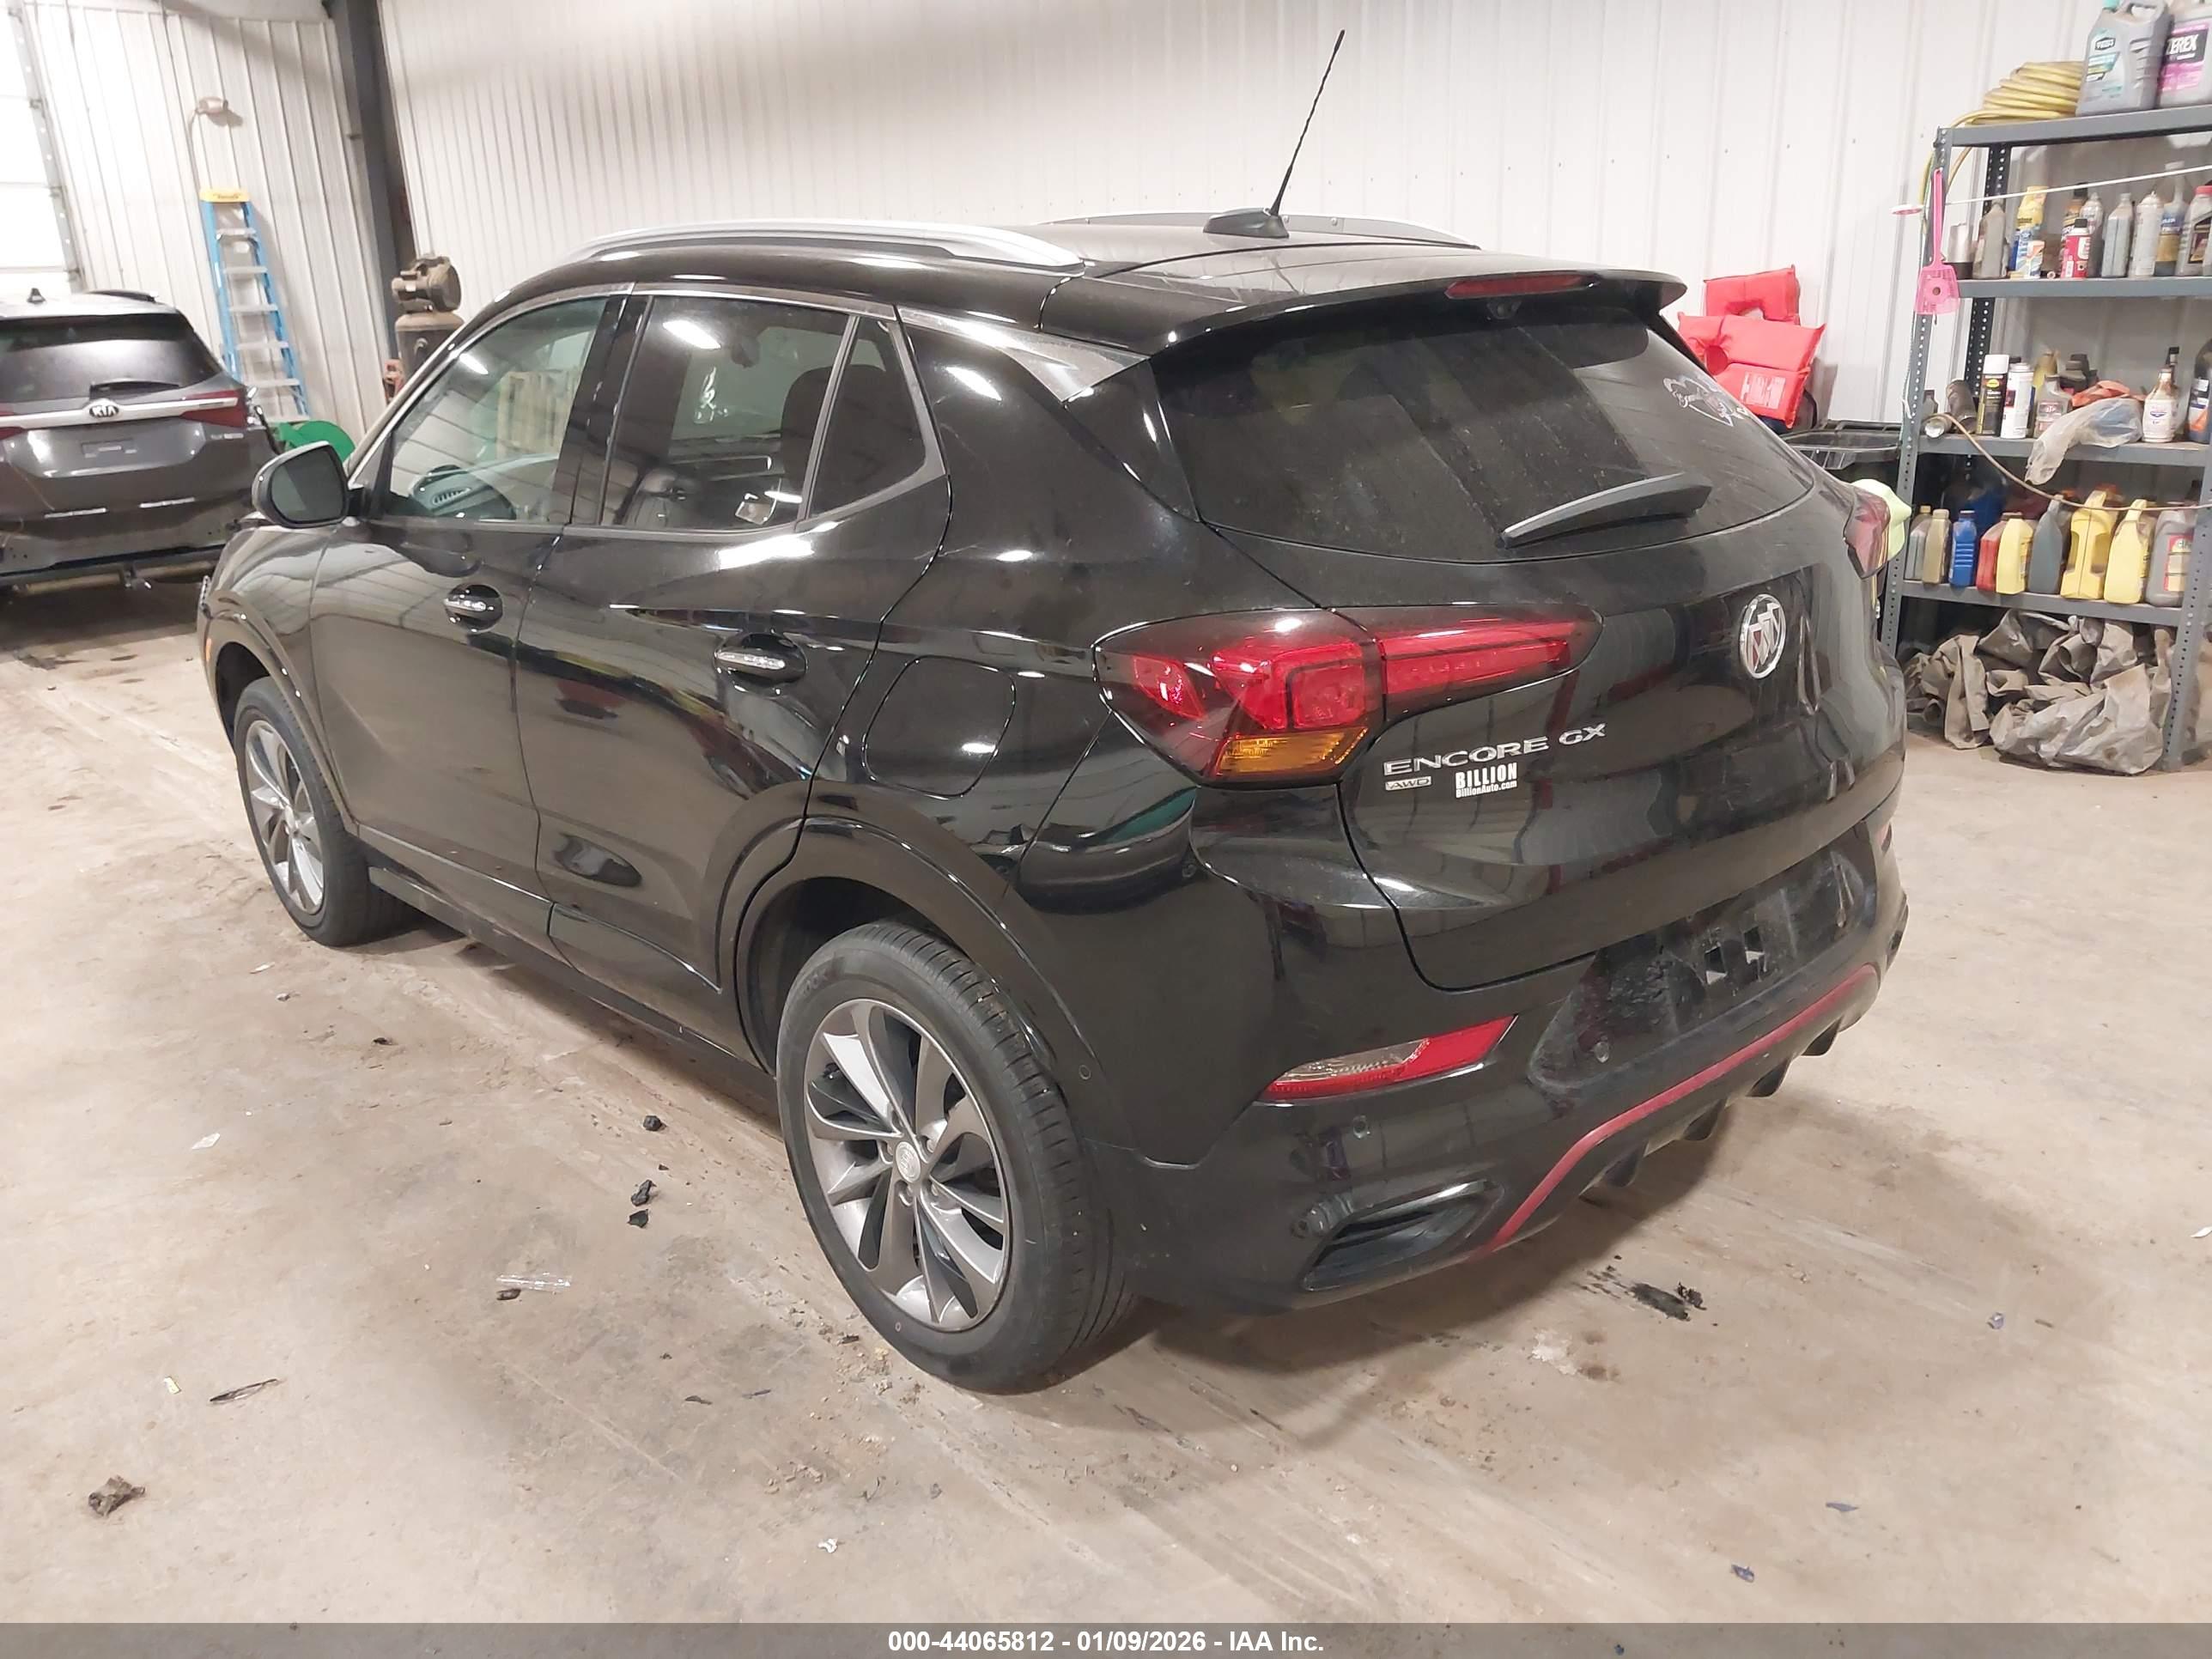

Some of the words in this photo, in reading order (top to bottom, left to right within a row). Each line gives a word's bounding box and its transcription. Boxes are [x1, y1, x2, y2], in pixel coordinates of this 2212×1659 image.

[91, 404, 118, 417] KIA
[1383, 736, 1549, 776] ENCORE
[1559, 723, 1606, 745] GX
[1388, 778, 1431, 789] AWD
[1455, 763, 1517, 789] BILLION
[1455, 781, 1517, 799] BillionAuto.com
